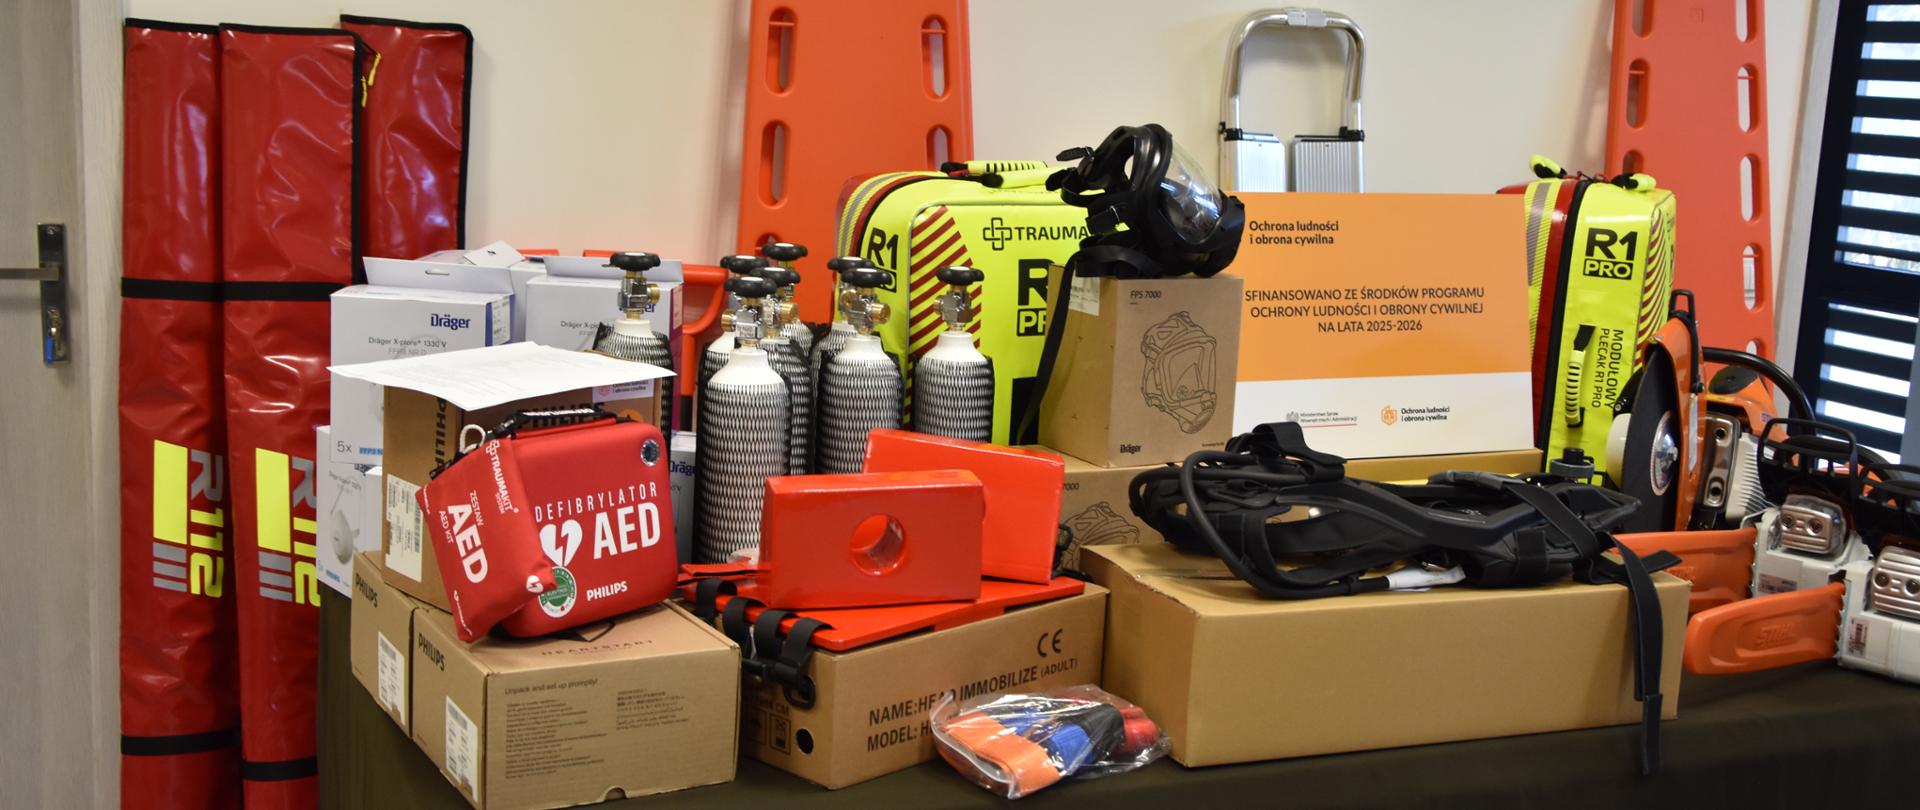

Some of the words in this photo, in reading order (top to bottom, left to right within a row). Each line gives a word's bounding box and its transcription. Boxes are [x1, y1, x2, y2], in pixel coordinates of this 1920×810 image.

[1249, 220, 1294, 231] Ochrona
[1297, 220, 1339, 231] ludności
[867, 227, 899, 271] R1
[1250, 234, 1253, 244] i
[1255, 234, 1293, 245] obrona
[1295, 234, 1334, 246] cywilna
[1585, 227, 1638, 261] R1
[1585, 260, 1632, 279] PRO
[1130, 290, 1145, 299] FPS
[1145, 290, 1162, 299] 7000
[1245, 288, 1342, 301] SFINANSOWANO
[1344, 288, 1358, 300] ZE
[1360, 285, 1419, 299] ŚRODKÓW
[1422, 287, 1485, 298] PROGRAMU
[1250, 305, 1311, 317] OCHRONY
[1313, 302, 1371, 316] LUDNOŚCI
[1374, 304, 1377, 315] I
[1380, 303, 1428, 315] OBRONY
[1430, 303, 1484, 314] CYWILNEJ
[431, 314, 471, 331] Dräger
[561, 320, 584, 330] Dräger
[1318, 321, 1335, 332] NA
[1337, 321, 1365, 332] LATA
[1366, 319, 1423, 332] 2025-2026
[368, 336, 392, 346] Dräger
[1597, 327, 1610, 369] PLECAK
[1595, 371, 1605, 384] R1
[1604, 328, 1624, 410] MODUŁOWY
[1592, 385, 1603, 408] PRO
[1425, 414, 1447, 422] cywilna
[1427, 405, 1450, 413] ludności
[337, 440, 353, 455] 5x
[1120, 444, 1142, 454] Dräger
[469, 489, 485, 527] ZESTAW
[534, 481, 657, 523] DEFIBRYLATOR
[191, 449, 224, 599] R112
[438, 510, 450, 529] AED
[445, 528, 454, 544] KIT
[593, 501, 661, 560] AED
[448, 504, 489, 584] AED
[355, 573, 378, 609] PHILIPS
[586, 580, 628, 601] PHILIPS
[418, 632, 446, 672] PHILIPS
[959, 665, 1038, 702] IMMOBILIZE
[1040, 657, 1078, 679] (ADULT)
[867, 726, 919, 752] MODEL:
